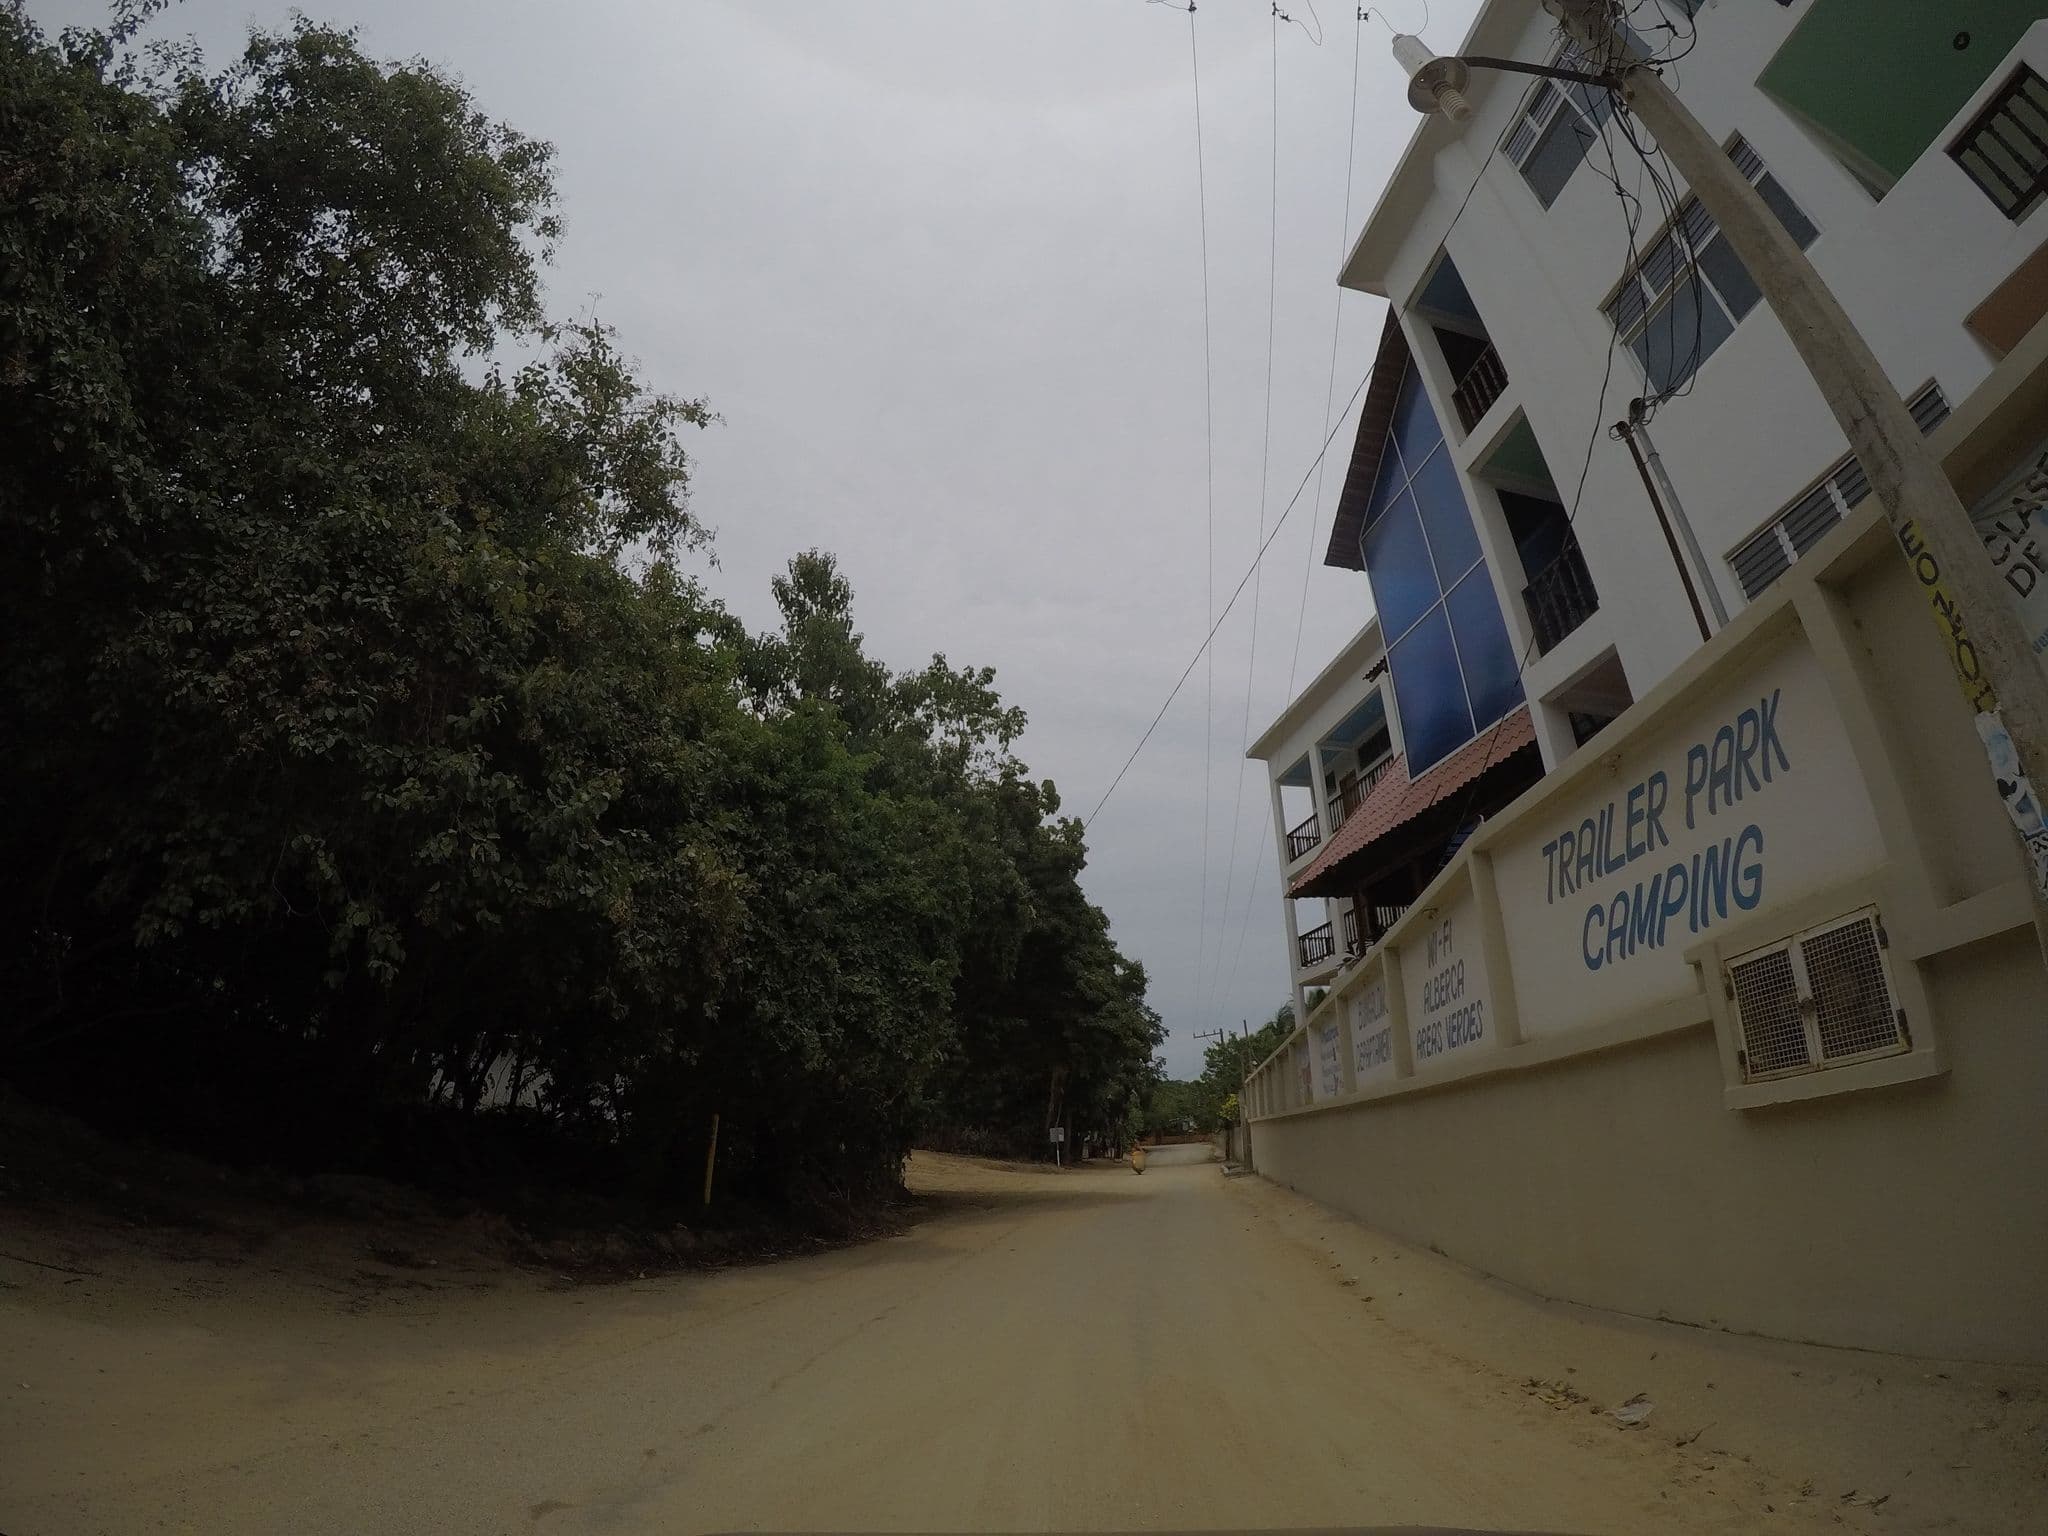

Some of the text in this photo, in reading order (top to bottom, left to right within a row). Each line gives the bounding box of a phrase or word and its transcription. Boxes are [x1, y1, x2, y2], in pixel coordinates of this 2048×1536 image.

[1542, 688, 1790, 904] TRAILER PARK
[1583, 824, 1763, 971] CAMPING
[1424, 959, 1465, 1014] ALBERCA
[1445, 1000, 1484, 1049] VERDES
